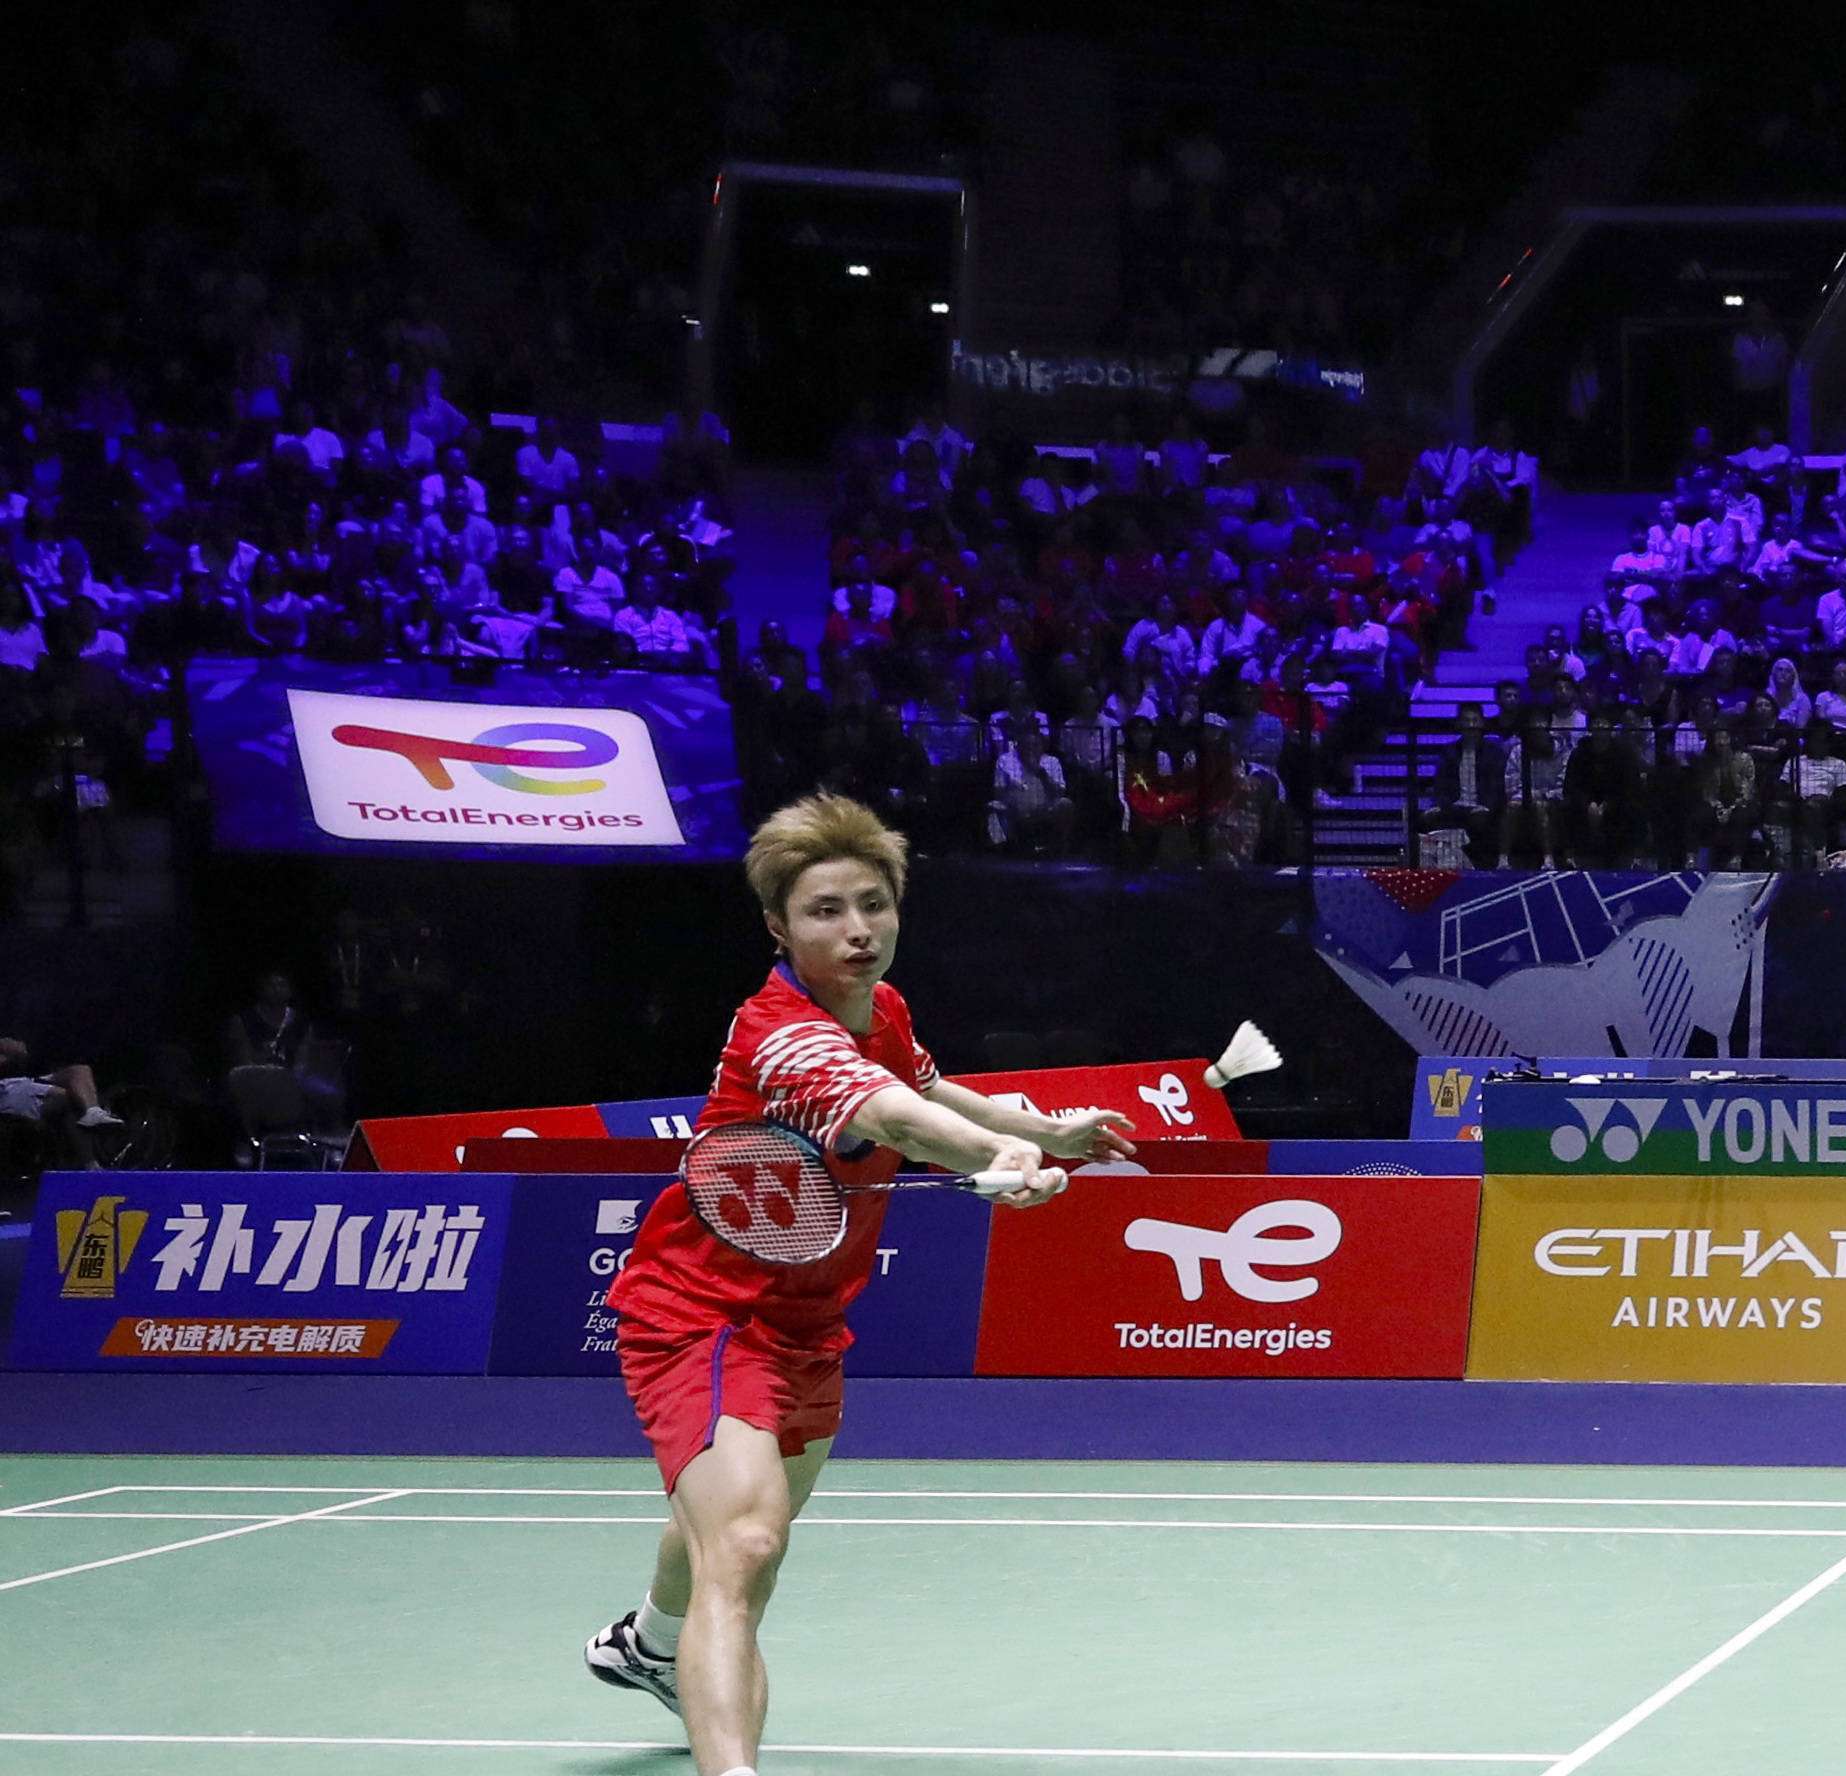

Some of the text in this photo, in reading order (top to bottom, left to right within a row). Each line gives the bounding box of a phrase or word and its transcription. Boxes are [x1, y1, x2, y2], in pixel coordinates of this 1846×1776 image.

[347, 801, 644, 832] TotalEnergies
[151, 1204, 485, 1292] 补水啦
[1611, 1297, 1822, 1330] AIRWAYS
[139, 1323, 367, 1353] 快速补充电解质
[1114, 1323, 1332, 1355] TotalEnergies
